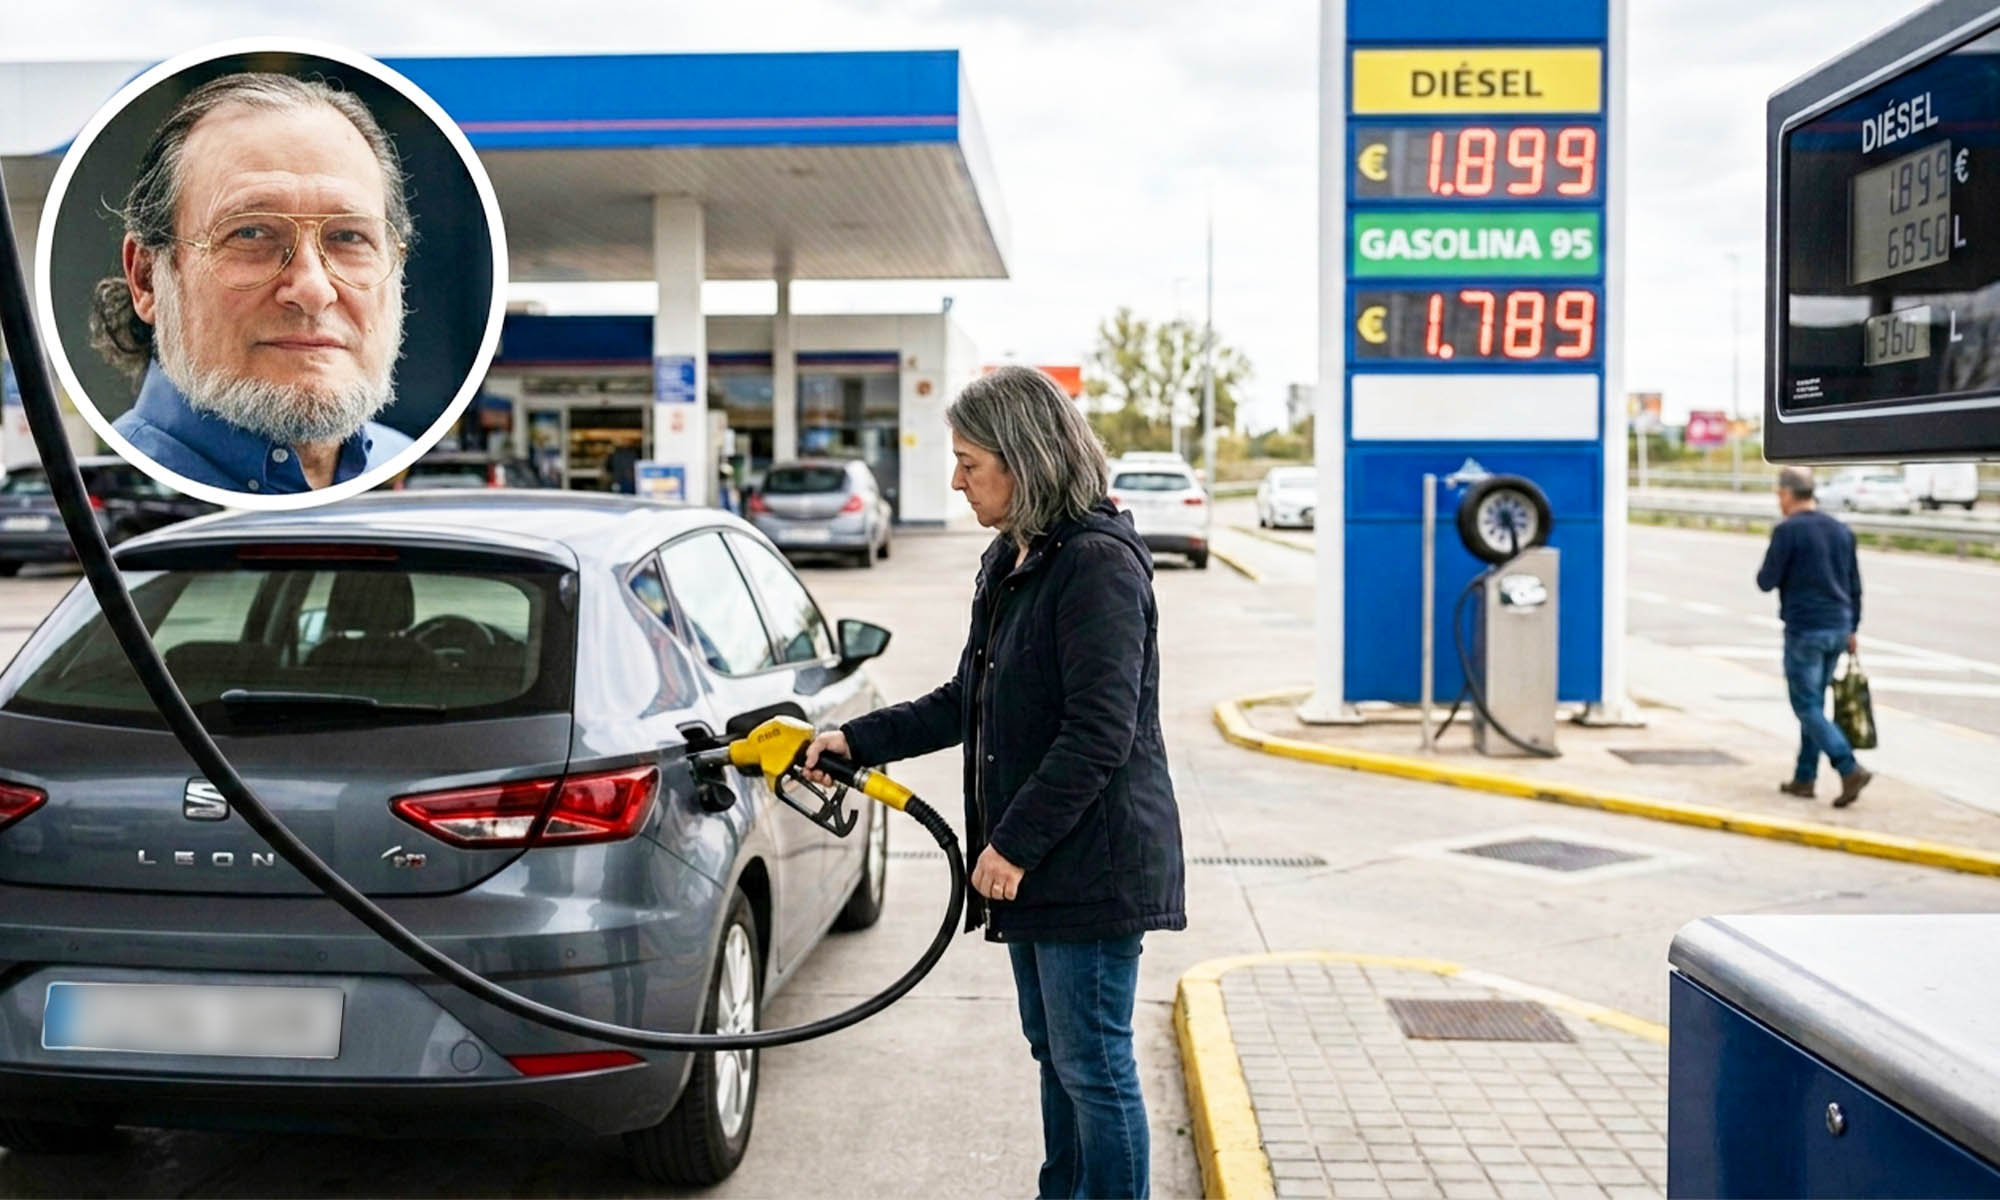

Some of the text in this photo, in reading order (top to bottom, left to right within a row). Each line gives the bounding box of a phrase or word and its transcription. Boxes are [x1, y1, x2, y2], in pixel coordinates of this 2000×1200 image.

[1410, 61, 1543, 98] DIÉSEL
[1861, 91, 1939, 154] DIÉSEL
[1357, 126, 1597, 196] € 1.899
[1954, 147, 1969, 183] €
[1359, 228, 1593, 260] GASOLINA 95
[1954, 214, 1967, 248] L
[1356, 290, 1596, 359] € 1.789
[1949, 309, 1963, 342] L
[137, 849, 275, 867] LEON
